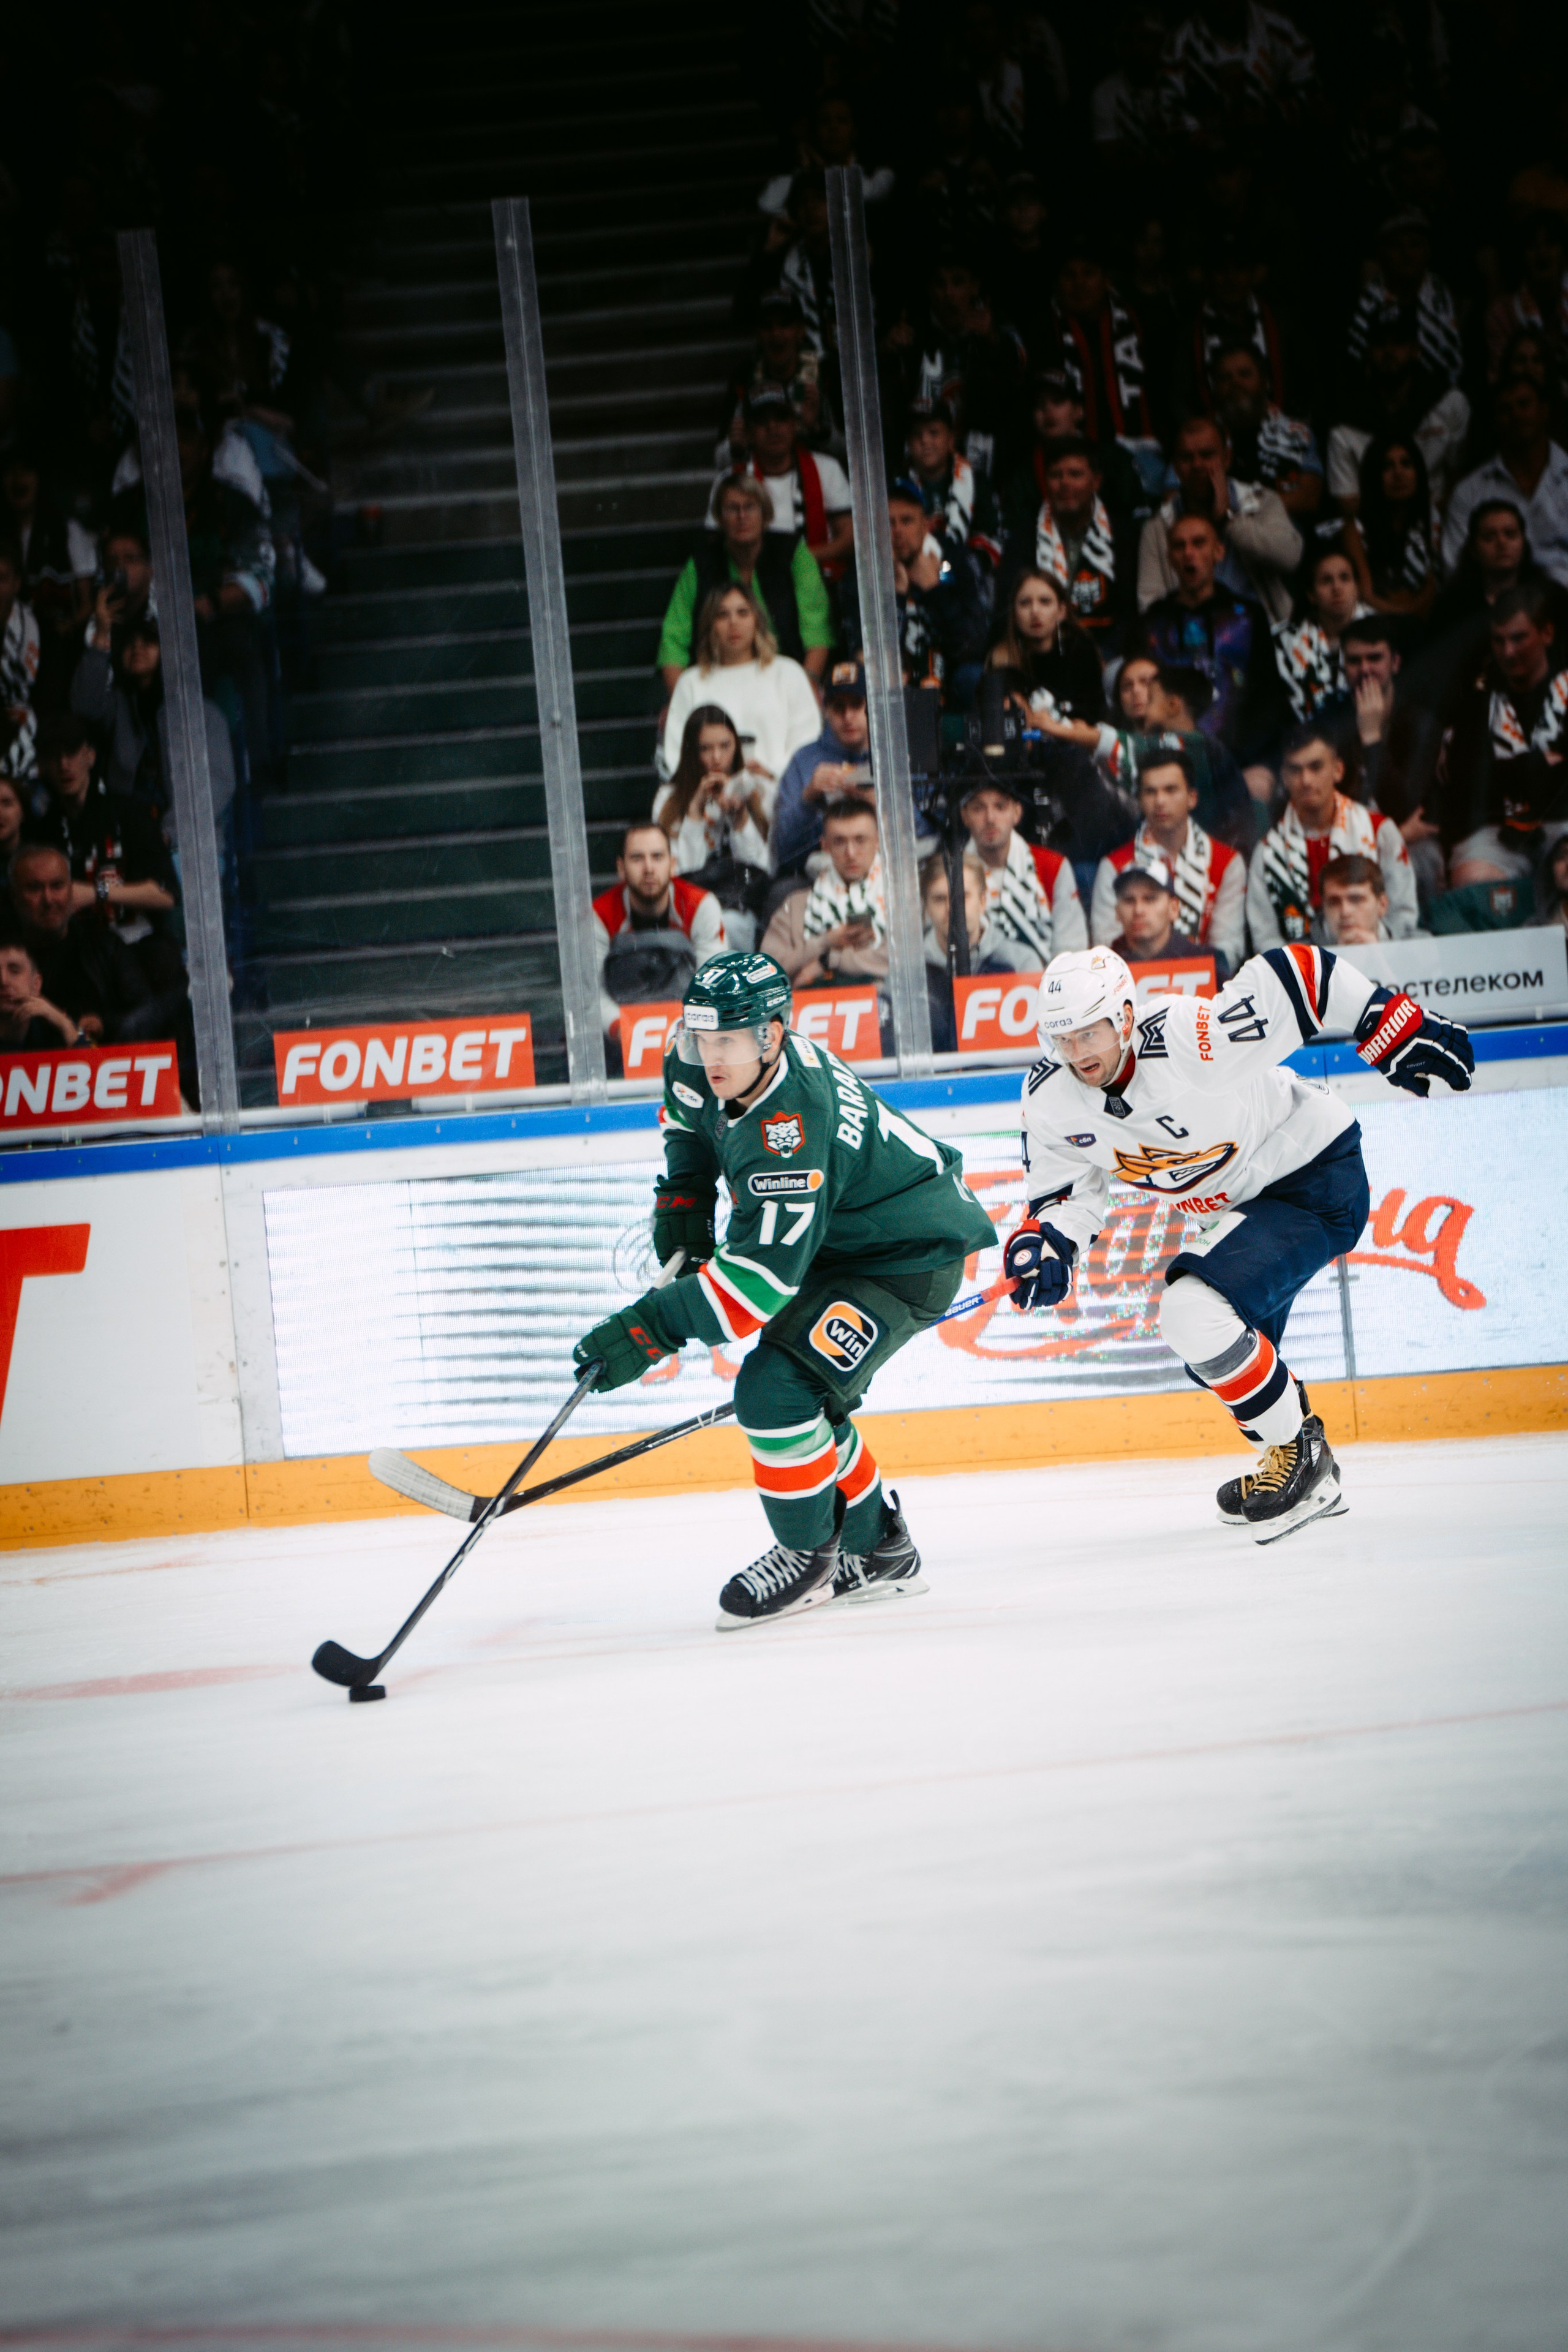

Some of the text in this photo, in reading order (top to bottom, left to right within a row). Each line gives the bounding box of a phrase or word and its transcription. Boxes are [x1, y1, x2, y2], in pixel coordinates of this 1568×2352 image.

[960, 970, 1211, 1041] FOET
[1048, 979, 1061, 994] 44
[1113, 974, 1128, 995] FONBET
[628, 999, 873, 1068] FET
[1196, 1005, 1214, 1061] FONBET
[1217, 994, 1269, 1042] 44
[282, 1027, 526, 1094] FONBET
[0, 1054, 172, 1117] NBET
[753, 1177, 807, 1191] Winline
[1175, 1192, 1232, 1214] NBET
[758, 1199, 816, 1246] 17
[829, 1319, 864, 1358] Win
